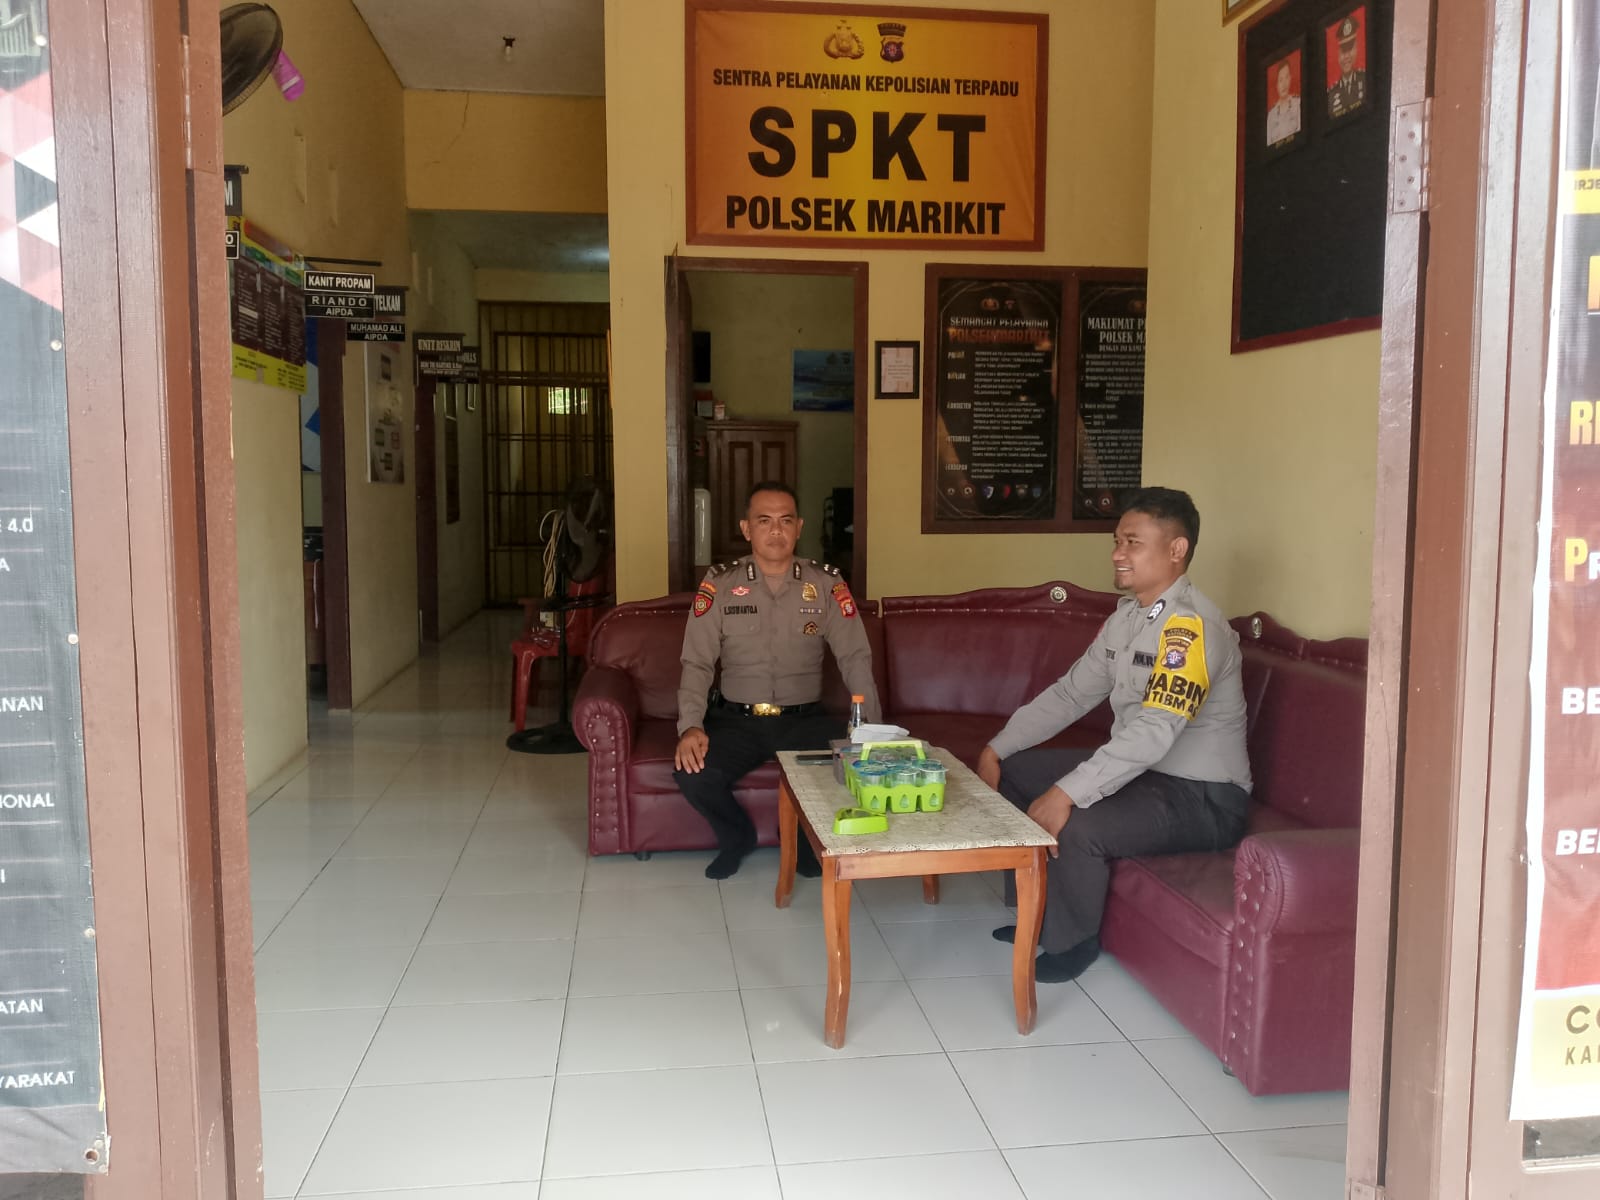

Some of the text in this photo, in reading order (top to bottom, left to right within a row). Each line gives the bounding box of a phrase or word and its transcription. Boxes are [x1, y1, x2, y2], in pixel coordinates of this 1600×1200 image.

[713, 68, 1019, 97] SENTRA PELAYANAN KEPOLISIAN TERPADU
[747, 105, 987, 183] SPKT
[726, 195, 1006, 235] POLSEK MARIKIT
[308, 275, 371, 289] KANIT PROPAM
[311, 295, 367, 307] RIANDO
[325, 307, 354, 317] AIPDA
[389, 324, 402, 333] ALI
[1087, 317, 1146, 330] MAKLUMAT P
[1099, 330, 1134, 343] POLSEK
[8, 517, 34, 533] 4.0
[0, 695, 45, 713] NAN
[1555, 829, 1600, 857] BE
[1565, 1004, 1600, 1035] C
